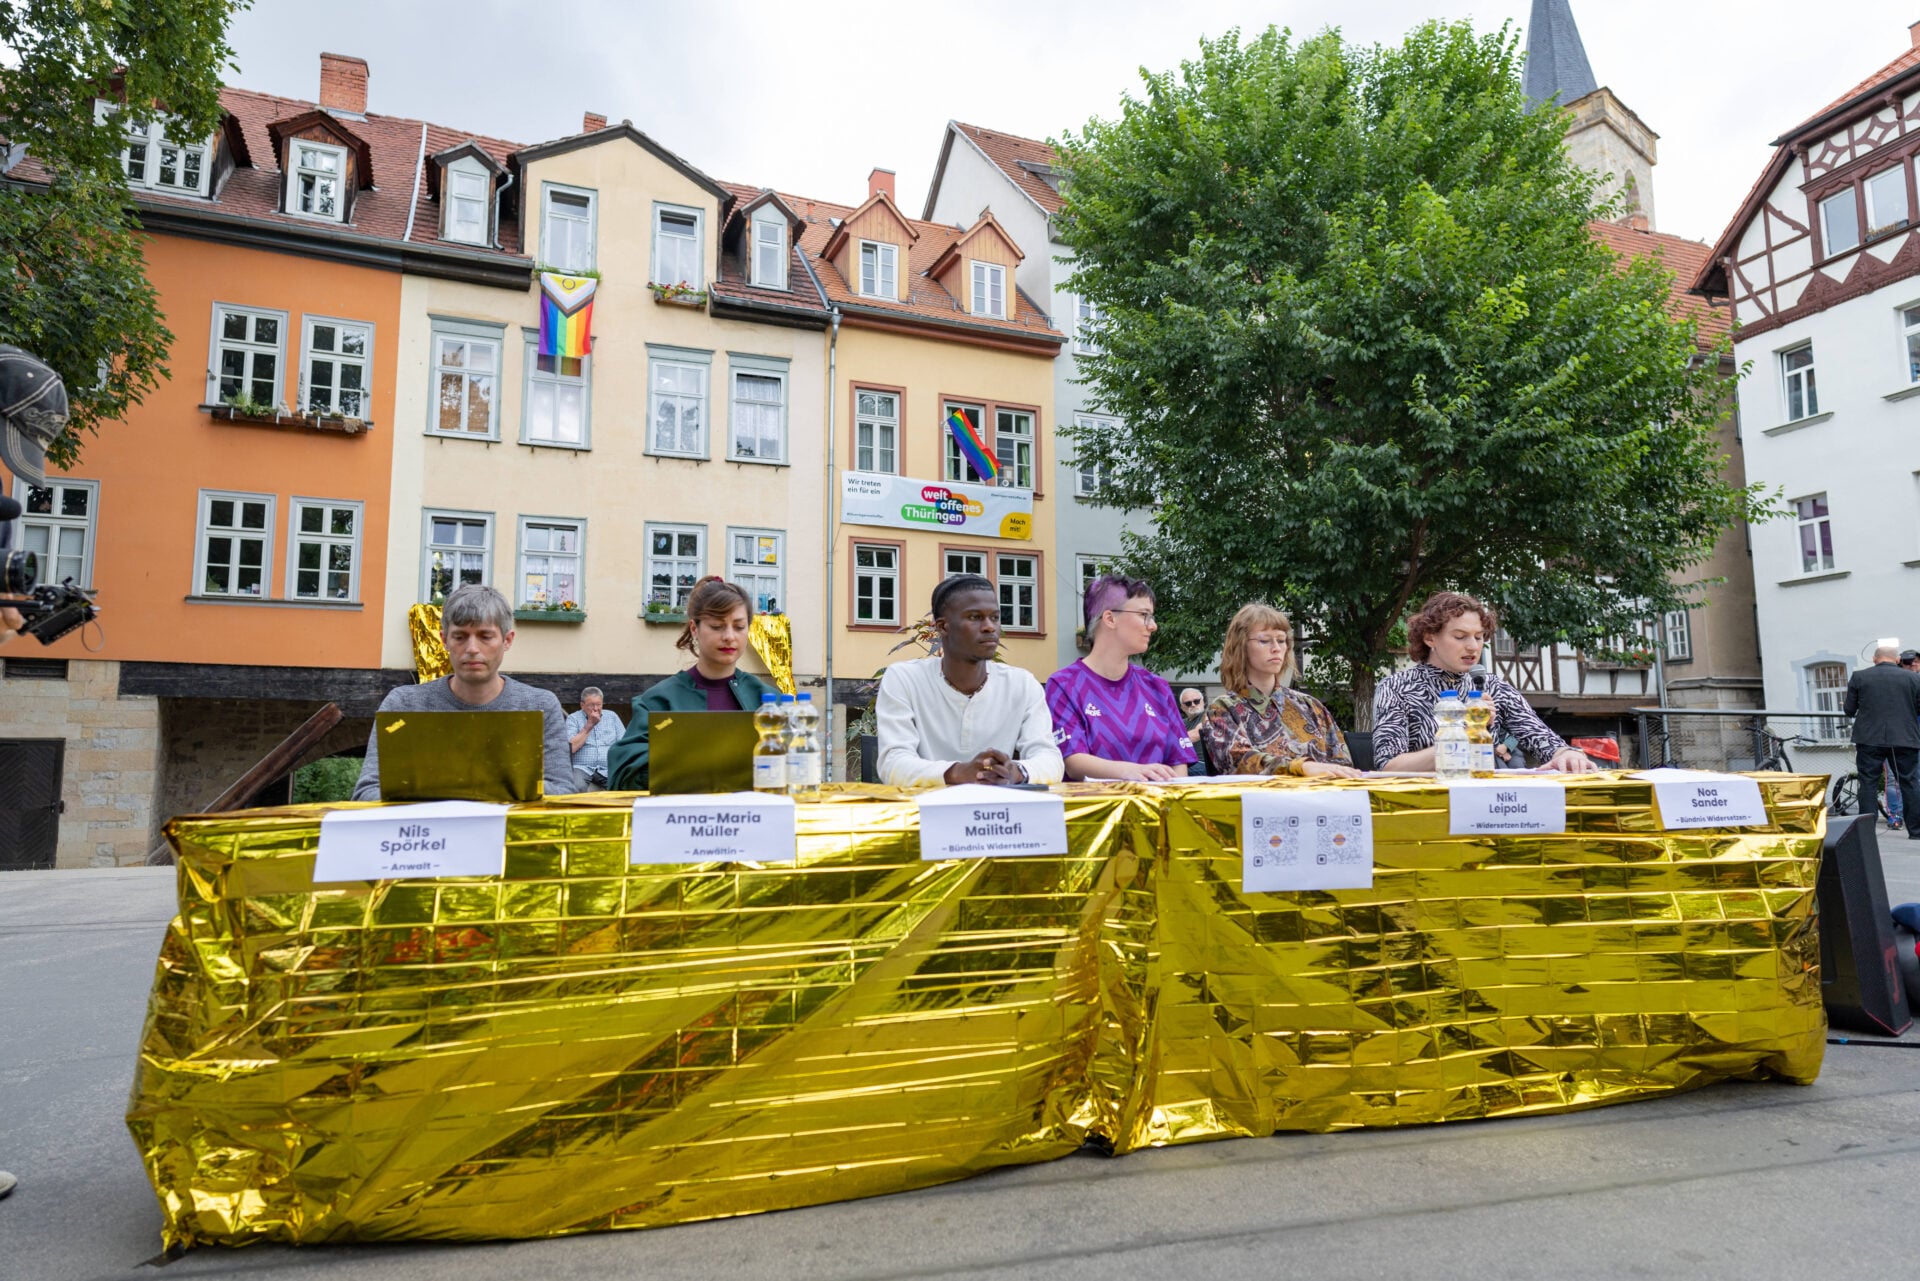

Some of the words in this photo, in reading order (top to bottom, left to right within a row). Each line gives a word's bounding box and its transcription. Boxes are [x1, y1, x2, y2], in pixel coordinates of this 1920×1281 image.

[861, 479, 882, 487] treten
[859, 486, 869, 494] für
[923, 489, 949, 501] welt
[940, 500, 981, 513] offenes
[904, 506, 963, 524] Thüringen
[1496, 791, 1517, 802] Niki
[1697, 787, 1718, 797] Noa
[1691, 797, 1728, 808] Sander
[973, 808, 1010, 823] Suraj
[1489, 803, 1528, 817] Leipold
[666, 811, 761, 824] Anna-Maria
[1680, 815, 1707, 824] Bündnis
[1706, 814, 1747, 822] Widersetzen
[398, 824, 430, 838] Nils
[690, 824, 740, 837] Müller
[965, 822, 1022, 837] Mailitafi
[1476, 821, 1519, 829] Widersetzen
[1520, 821, 1540, 829] Erfurt
[380, 838, 446, 856] Spörkel
[692, 847, 737, 856] Anwältin
[949, 843, 985, 853] Bündnis
[986, 841, 1040, 851] Widersetzen
[390, 862, 431, 871] Anwalt
